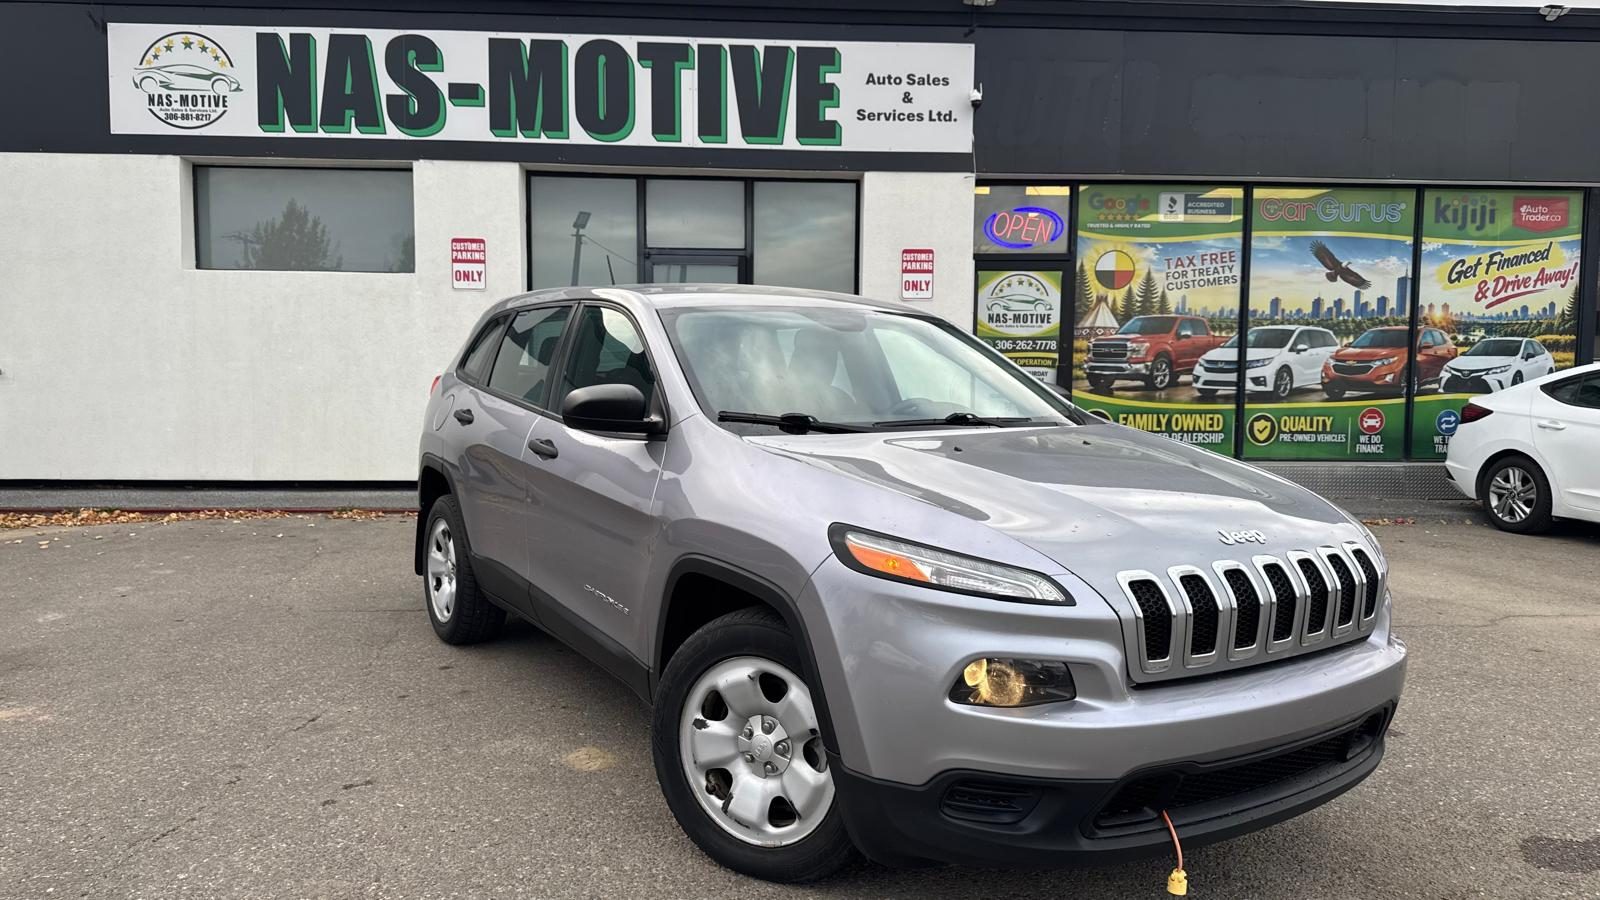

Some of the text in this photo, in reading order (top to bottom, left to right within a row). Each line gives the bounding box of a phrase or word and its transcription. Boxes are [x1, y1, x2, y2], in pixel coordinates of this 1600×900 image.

[865, 73, 950, 86] Auto Sales
[256, 32, 842, 145] NAS-MOTIVE
[148, 93, 228, 108] NAS-MOTIVE
[901, 91, 914, 104] &
[164, 112, 211, 121] 306-881-8217
[856, 108, 958, 122] Services Ltd.
[1088, 192, 1150, 216] Google
[1526, 204, 1548, 213] Auto
[1434, 195, 1497, 231] kijiji
[1520, 213, 1561, 222] Trader.ca
[993, 212, 1052, 243] OPEN
[453, 242, 484, 250] CUSTOMER
[453, 251, 485, 260] PARKING
[903, 253, 933, 261] CUSTOMER
[1164, 251, 1236, 270] TAX FREE
[903, 262, 933, 270] PARKING
[1448, 241, 1553, 284] Get Financed
[455, 270, 483, 282] ONLY
[1165, 265, 1235, 280] FOR TREATY
[904, 280, 930, 291] ONLY
[1166, 274, 1238, 291] CUSTOMERS
[1474, 262, 1578, 302] & Drive Away!
[987, 313, 1052, 324] NAS-MOTIVE
[995, 340, 1057, 350] 306-262-7778
[1119, 413, 1223, 431] FAMILY OWNED
[1281, 416, 1333, 432] QUALITY
[1171, 432, 1224, 444] DEALERSHIP
[1279, 433, 1346, 442] PRE-OWNED VEHICLES
[1359, 435, 1381, 444] WE DO
[1433, 436, 1444, 444] WE
[1356, 444, 1384, 453] FINANCE
[1216, 528, 1266, 545] Jeep
